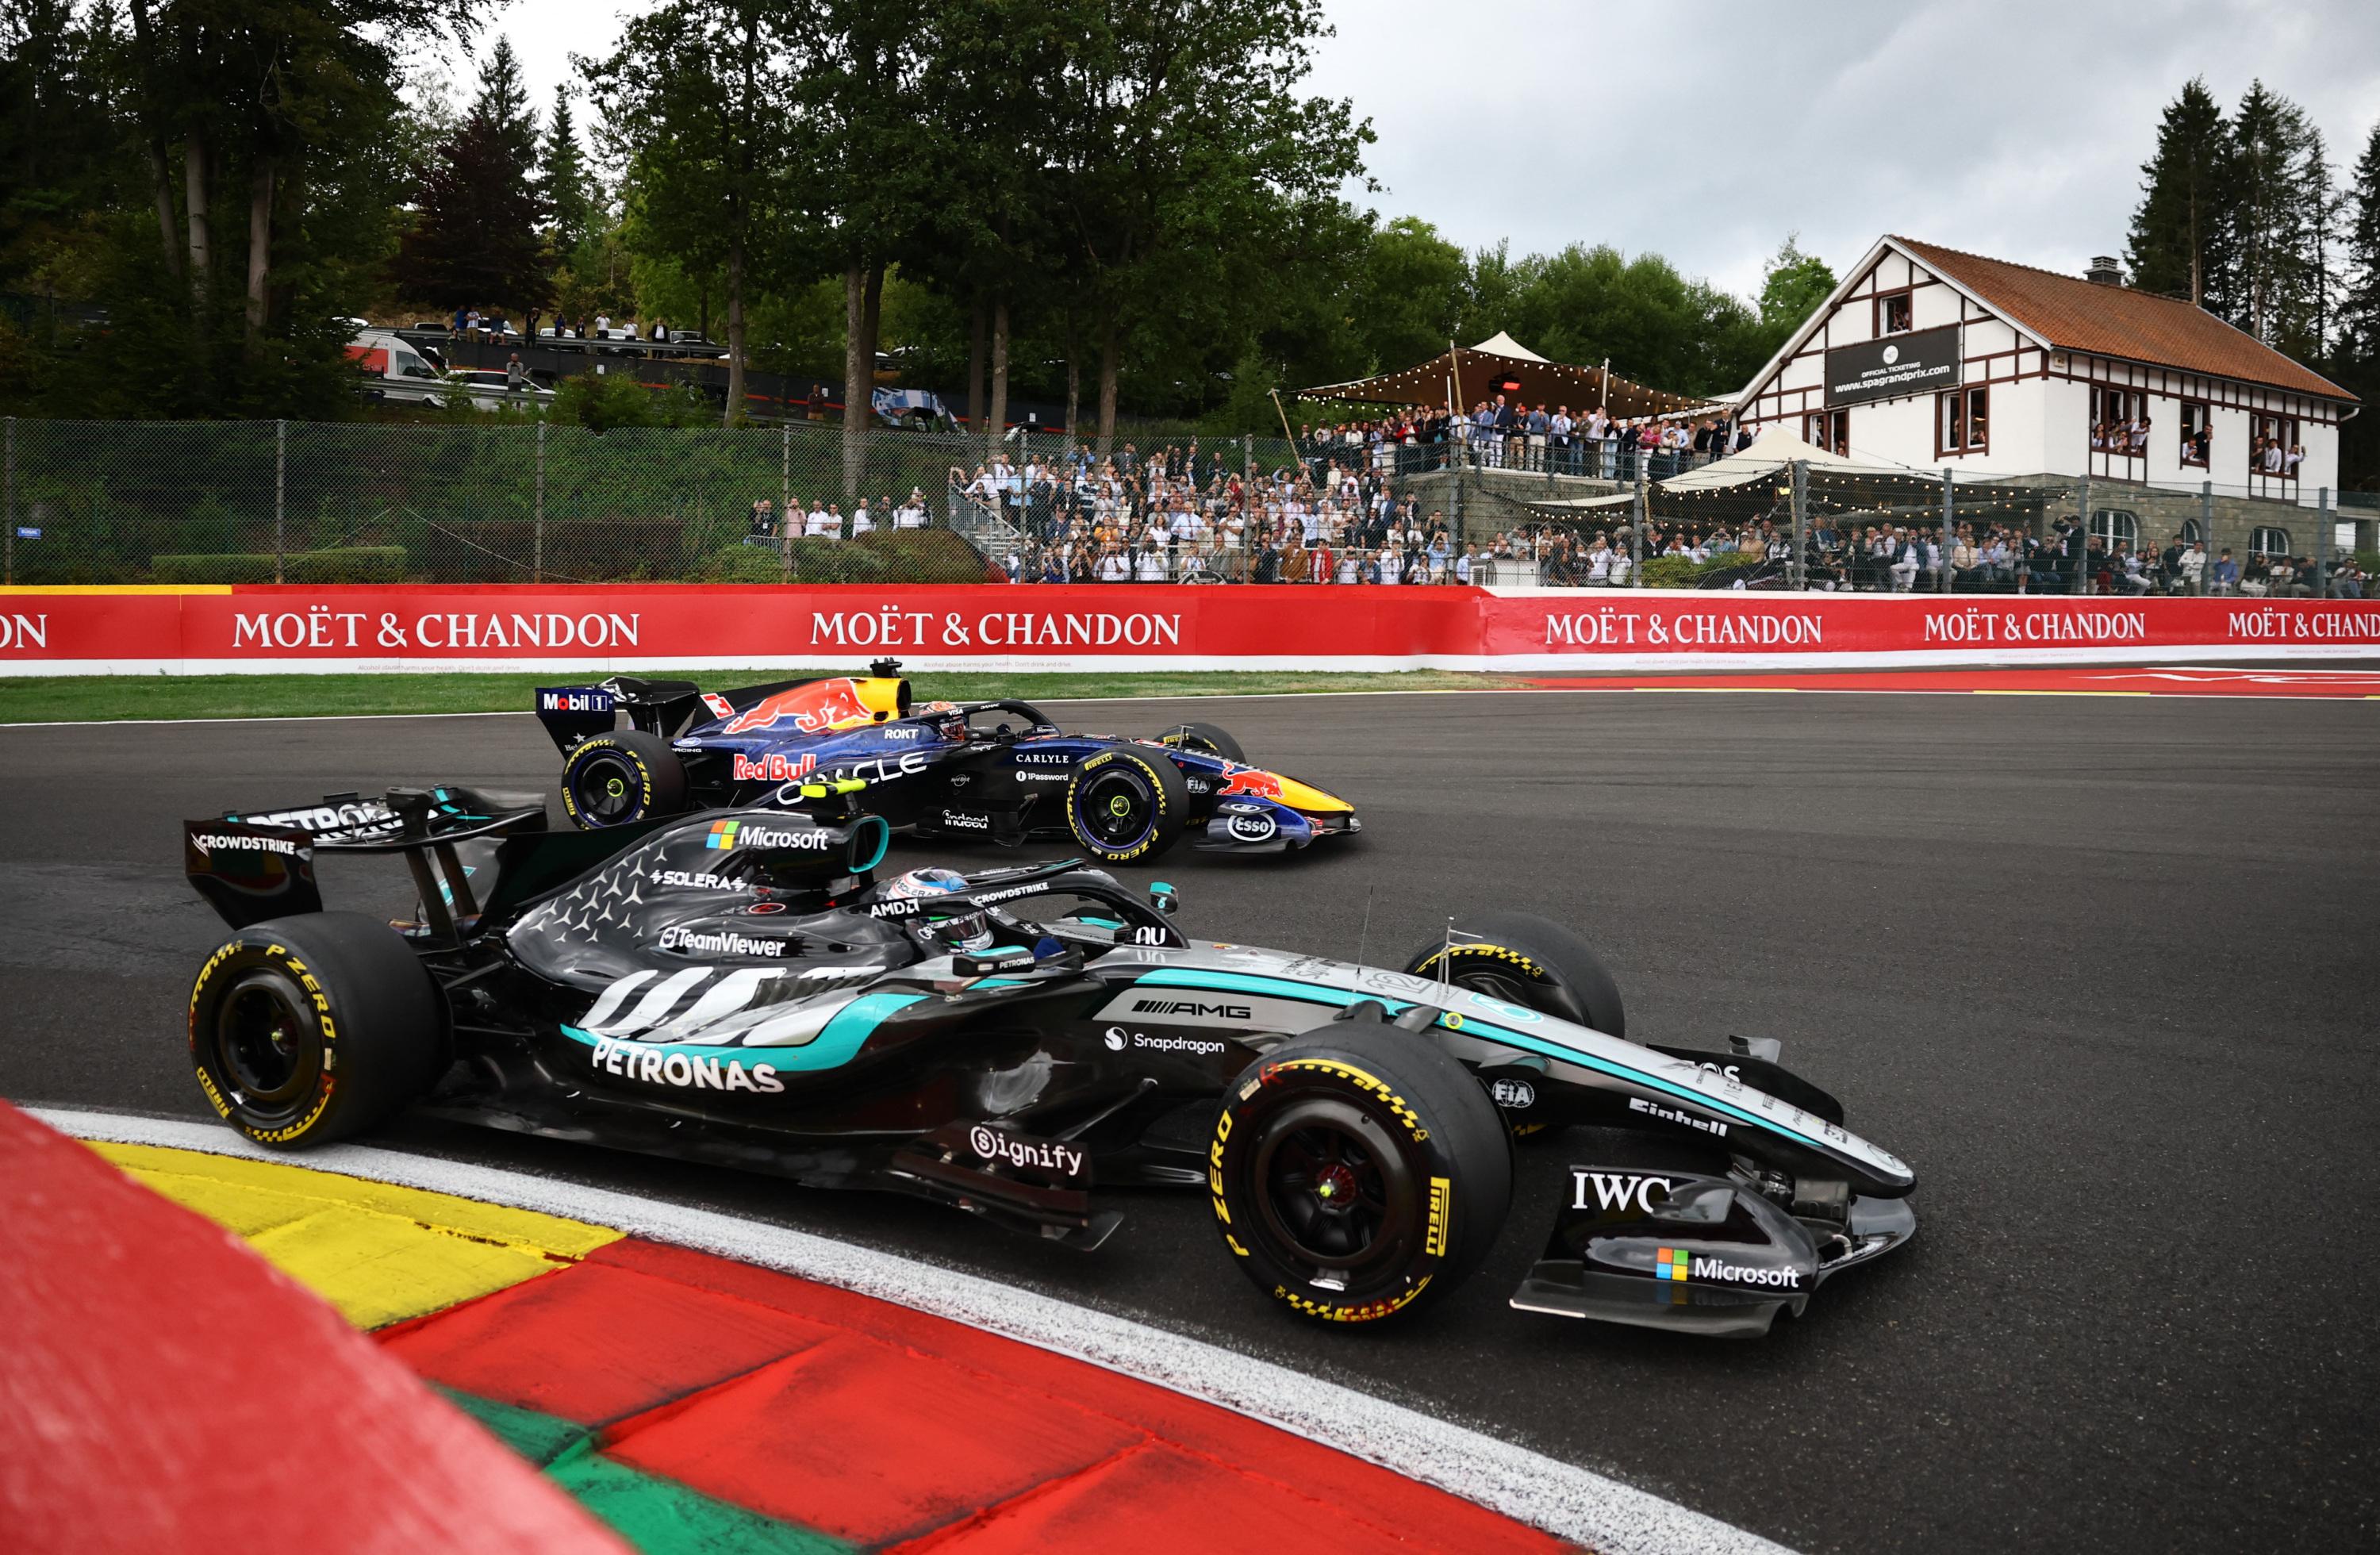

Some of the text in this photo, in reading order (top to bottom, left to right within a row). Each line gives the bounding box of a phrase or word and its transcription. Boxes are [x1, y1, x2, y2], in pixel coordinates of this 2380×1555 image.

[1835, 364, 1950, 393] www.spagrandprix.com
[1861, 362, 1921, 378] OFFICIAL TICKETING
[232, 605, 640, 648] MOËT & CHANDON
[810, 605, 1181, 646] MOËT & CHANDON
[1545, 607, 1822, 644] MOËT & CHANDON
[1925, 608, 2145, 641] MOËT & CHANDON
[2228, 607, 2290, 637] MOËT
[2294, 613, 2309, 638] &
[543, 693, 589, 711] Mobil
[885, 728, 919, 739] ROKT
[733, 753, 816, 781] Red Bull
[1015, 754, 1069, 763] CARLYLE
[1084, 753, 1112, 771] PIRELLI
[635, 761, 651, 806] ZERO
[777, 751, 927, 805] OCLE
[1027, 773, 1069, 781] 1Password
[739, 826, 828, 850] Microsoft
[1235, 817, 1269, 832] Esso
[199, 833, 295, 855] CROWDSTRIKE
[1107, 828, 1159, 861] P ZERO
[662, 870, 731, 890] SOLERA
[974, 881, 1049, 904] CROWDSTRIKE
[870, 901, 906, 918] AMD
[678, 928, 785, 957] TeamViewer
[999, 956, 1035, 969] PETRONAS
[266, 943, 286, 957] P
[286, 957, 336, 1039] ZERO
[1169, 1002, 1251, 1019] AMG
[1134, 1033, 1225, 1055] Snapdragon
[592, 1039, 785, 1093] PETRONAS
[196, 1066, 234, 1119] PIRELLI
[1629, 1097, 1728, 1138] Einhell
[1210, 1109, 1250, 1256] P ZERO
[1572, 1172, 1670, 1214] IWC
[1426, 1177, 1450, 1257] PIRELLI
[1695, 1257, 1799, 1288] Microsoft
